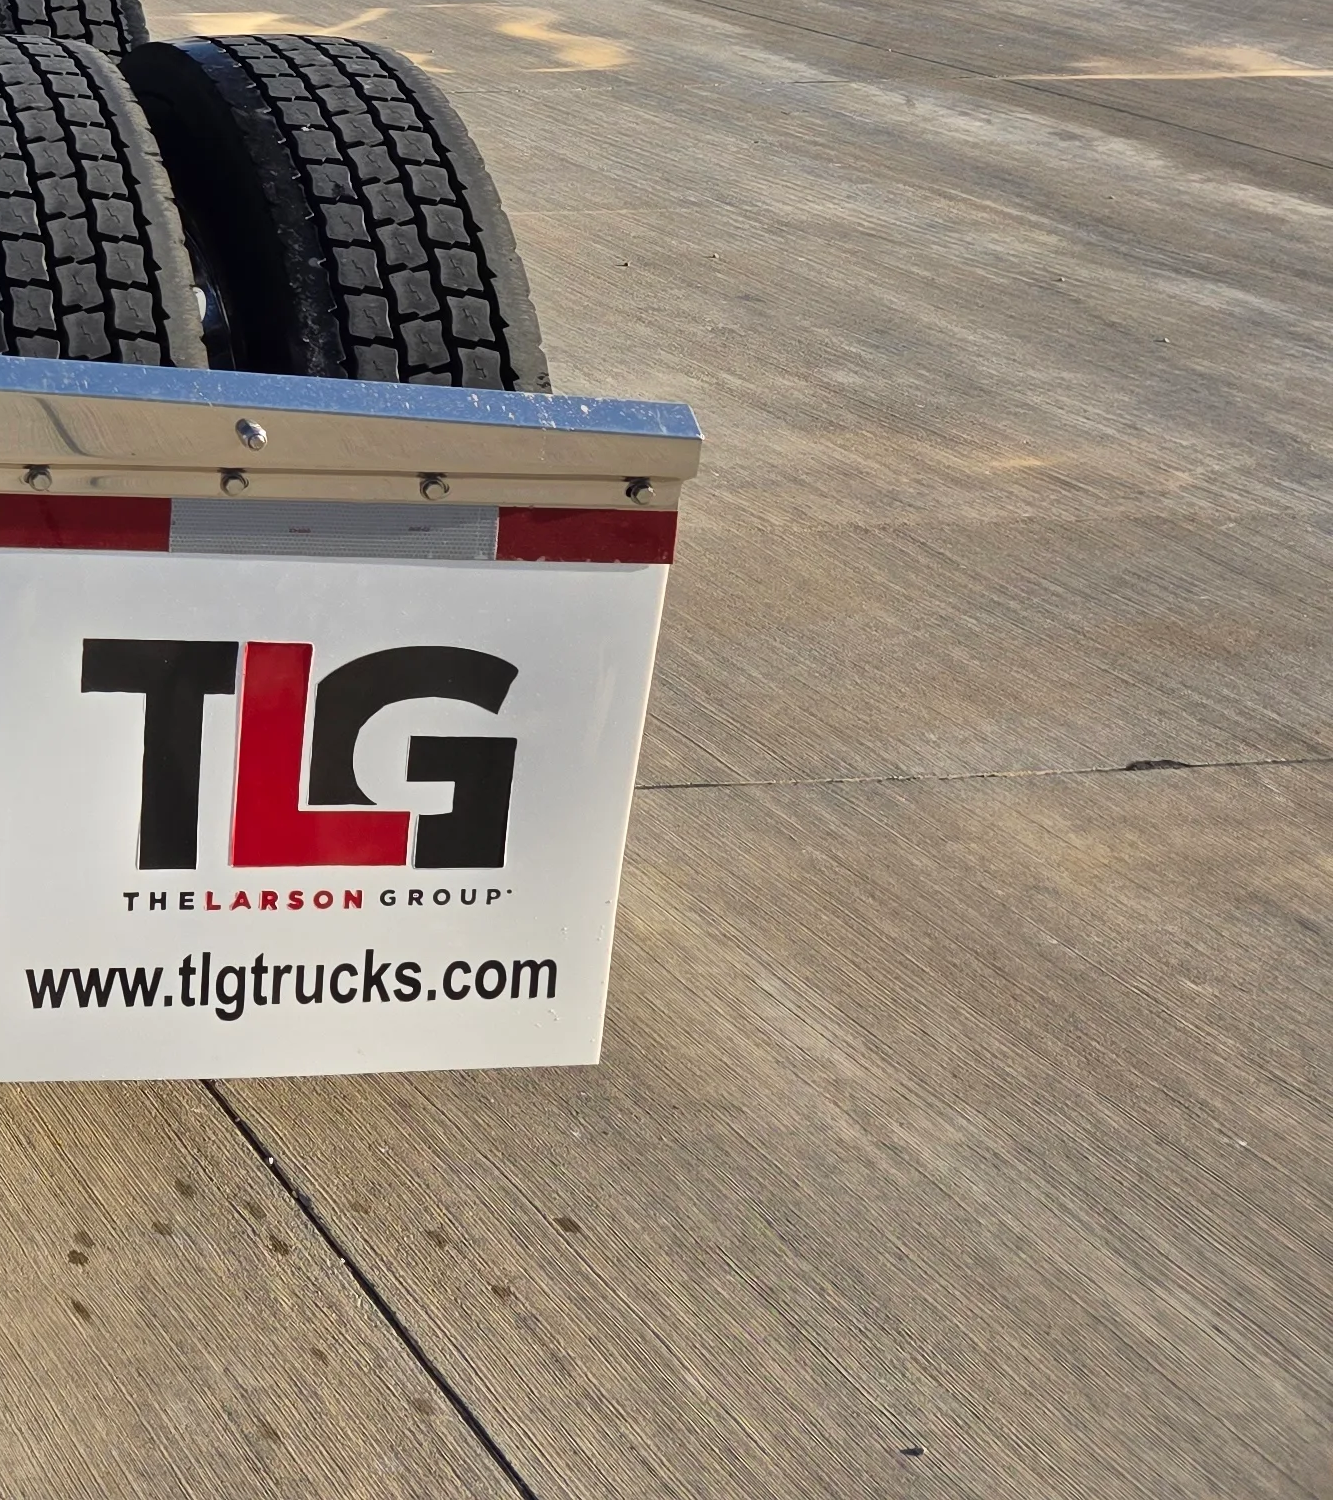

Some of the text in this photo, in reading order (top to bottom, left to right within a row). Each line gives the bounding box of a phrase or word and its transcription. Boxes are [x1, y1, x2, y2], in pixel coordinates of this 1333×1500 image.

[80, 638, 519, 870] TLG
[379, 888, 501, 907] GROUP
[25, 948, 557, 1022] www.tlgtrucks.com
